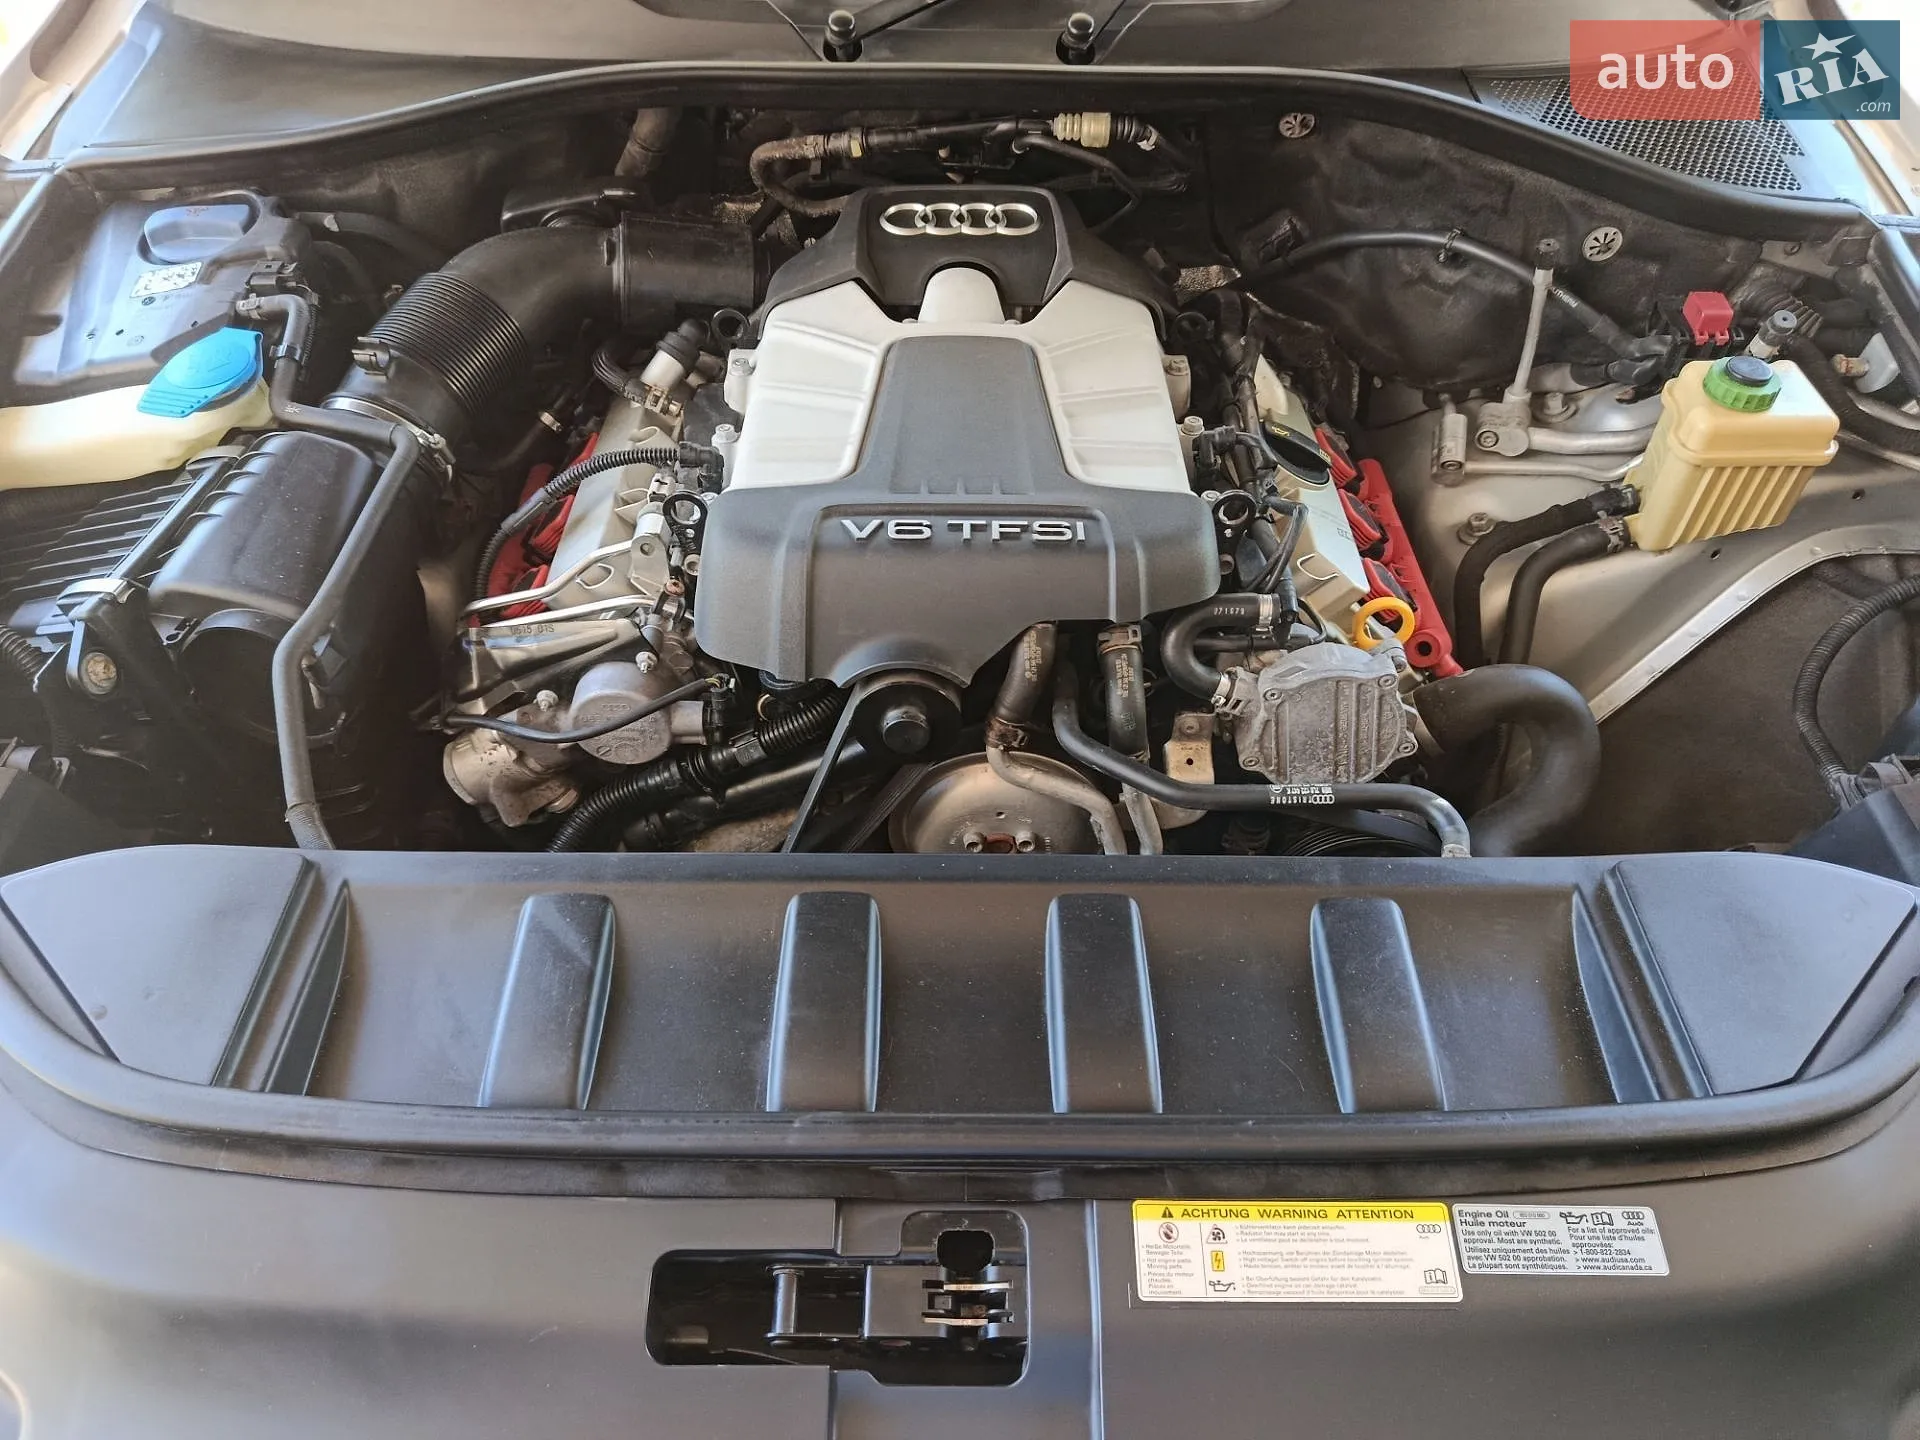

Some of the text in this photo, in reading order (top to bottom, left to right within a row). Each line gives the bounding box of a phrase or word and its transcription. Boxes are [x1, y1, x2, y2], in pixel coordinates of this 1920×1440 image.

[840, 519, 1086, 543] V6 TFSI
[1270, 796, 1312, 805] TRISTONE
[1181, 1208, 1415, 1220] ACHTUNG WARNING ATTENTION
[1458, 1209, 1493, 1219] Engine
[1495, 1210, 1509, 1218] Oil
[1460, 1219, 1527, 1228] Huile moteur
[1608, 1226, 1640, 1235] approved
[1491, 1247, 1533, 1255] uniquement
[1478, 1262, 1503, 1270] plupart
